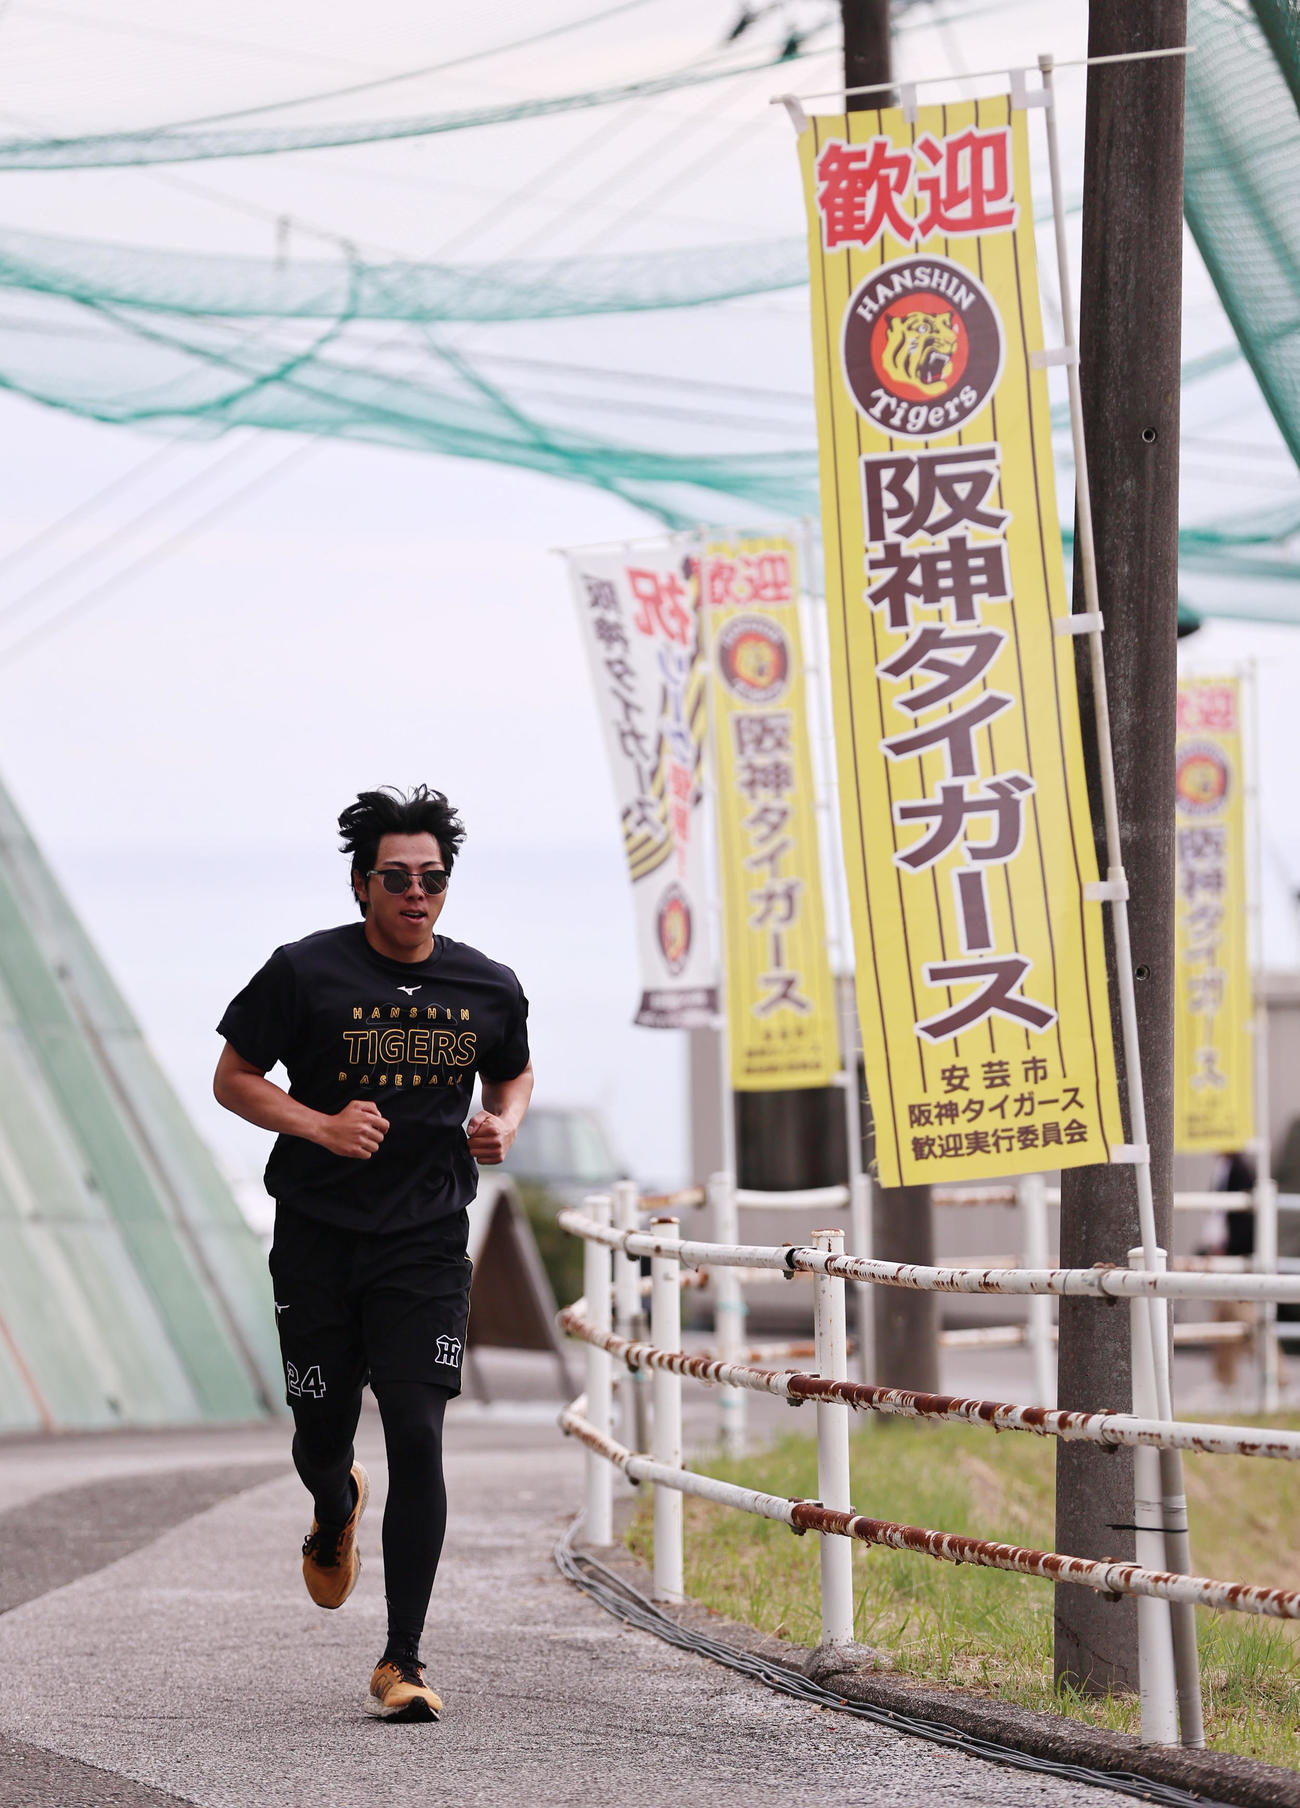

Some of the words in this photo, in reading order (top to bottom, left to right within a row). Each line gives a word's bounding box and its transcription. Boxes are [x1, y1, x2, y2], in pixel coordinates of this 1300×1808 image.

[816, 126, 1019, 250] 歓迎
[856, 266, 977, 322] HANSHIN
[869, 385, 978, 432] Tigers
[860, 443, 1060, 1044] 阪神タイガース
[353, 1007, 470, 1021] HANSHIN
[343, 1029, 477, 1067] TIGERS
[941, 1056, 1048, 1093] 安芸市
[908, 1087, 1084, 1128] 阪神タイガース
[911, 1119, 1088, 1161] 歓迎実行委員会
[287, 1361, 326, 1399] 24
